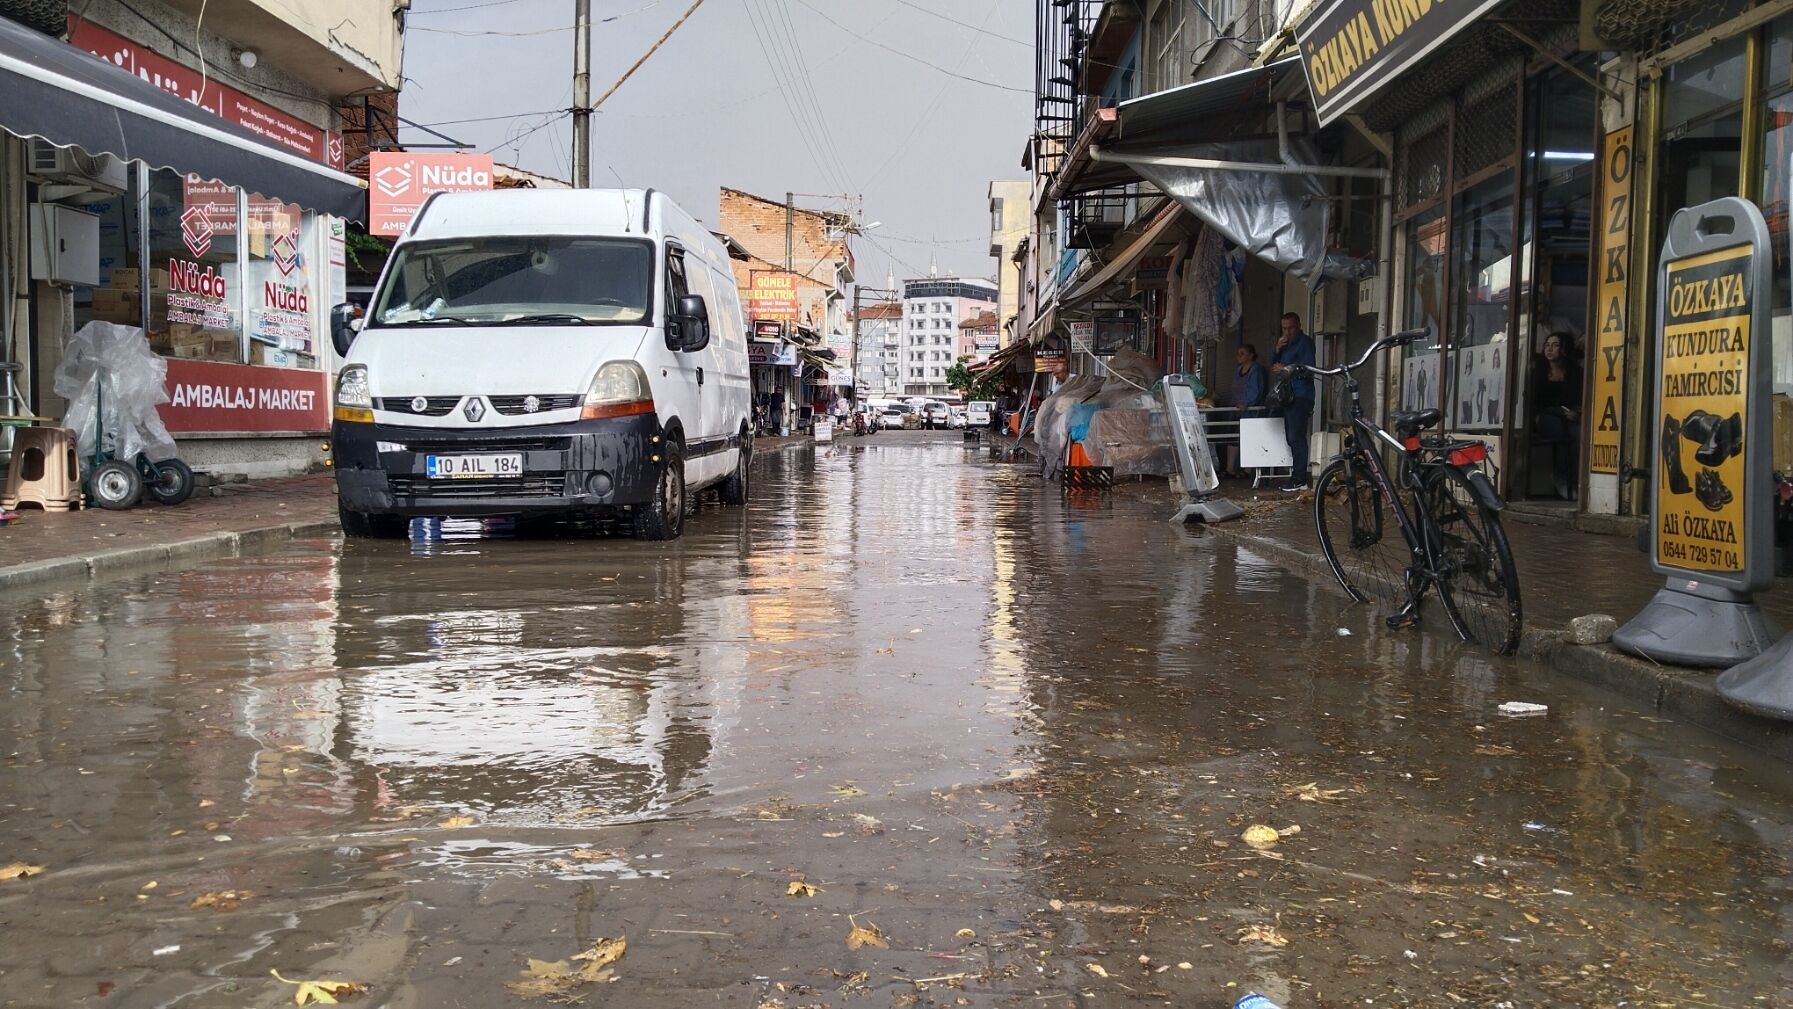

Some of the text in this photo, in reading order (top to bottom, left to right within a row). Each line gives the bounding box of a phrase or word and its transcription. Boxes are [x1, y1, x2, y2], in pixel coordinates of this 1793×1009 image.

[1308, 0, 1444, 97] ÖZKAYA KUN
[422, 165, 489, 186] Nüda
[170, 257, 226, 300] Nüda
[1598, 134, 1630, 431] ÖZKAYA
[1670, 272, 1746, 318] ÖZKAYA
[167, 293, 195, 308] Plastik
[265, 280, 308, 313] Nüda
[1665, 325, 1745, 360] KUNDURA
[1664, 359, 1743, 398] TAMİRCİSİ
[172, 383, 315, 411] AMBALAJ MARKET
[438, 457, 519, 473] 10 AIL 184
[1663, 510, 1738, 544] Ali ÖZKAYA
[1663, 540, 1739, 569] 0544 729 57 04
